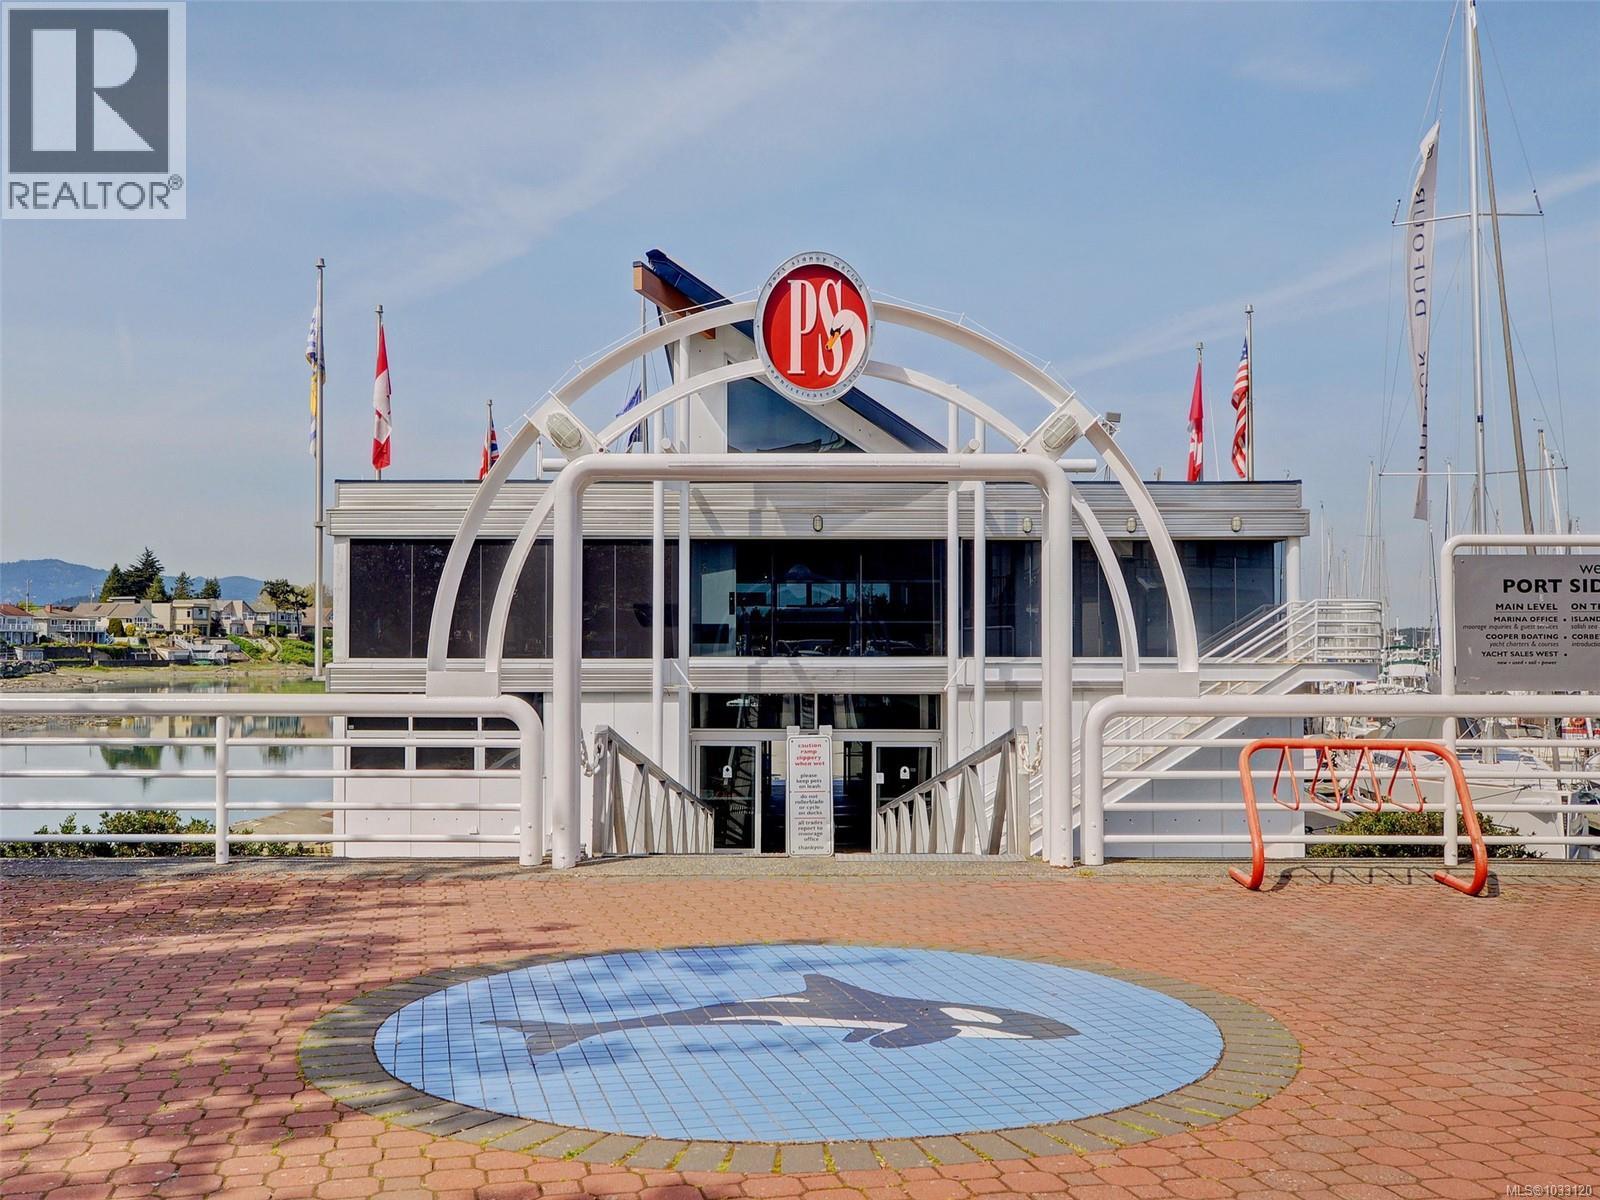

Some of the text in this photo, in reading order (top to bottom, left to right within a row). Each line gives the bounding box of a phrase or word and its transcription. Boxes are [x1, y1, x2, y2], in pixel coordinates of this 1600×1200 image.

[1503, 578, 1600, 593] PORT SID
[1495, 603, 1558, 611] MAIN LEVEL
